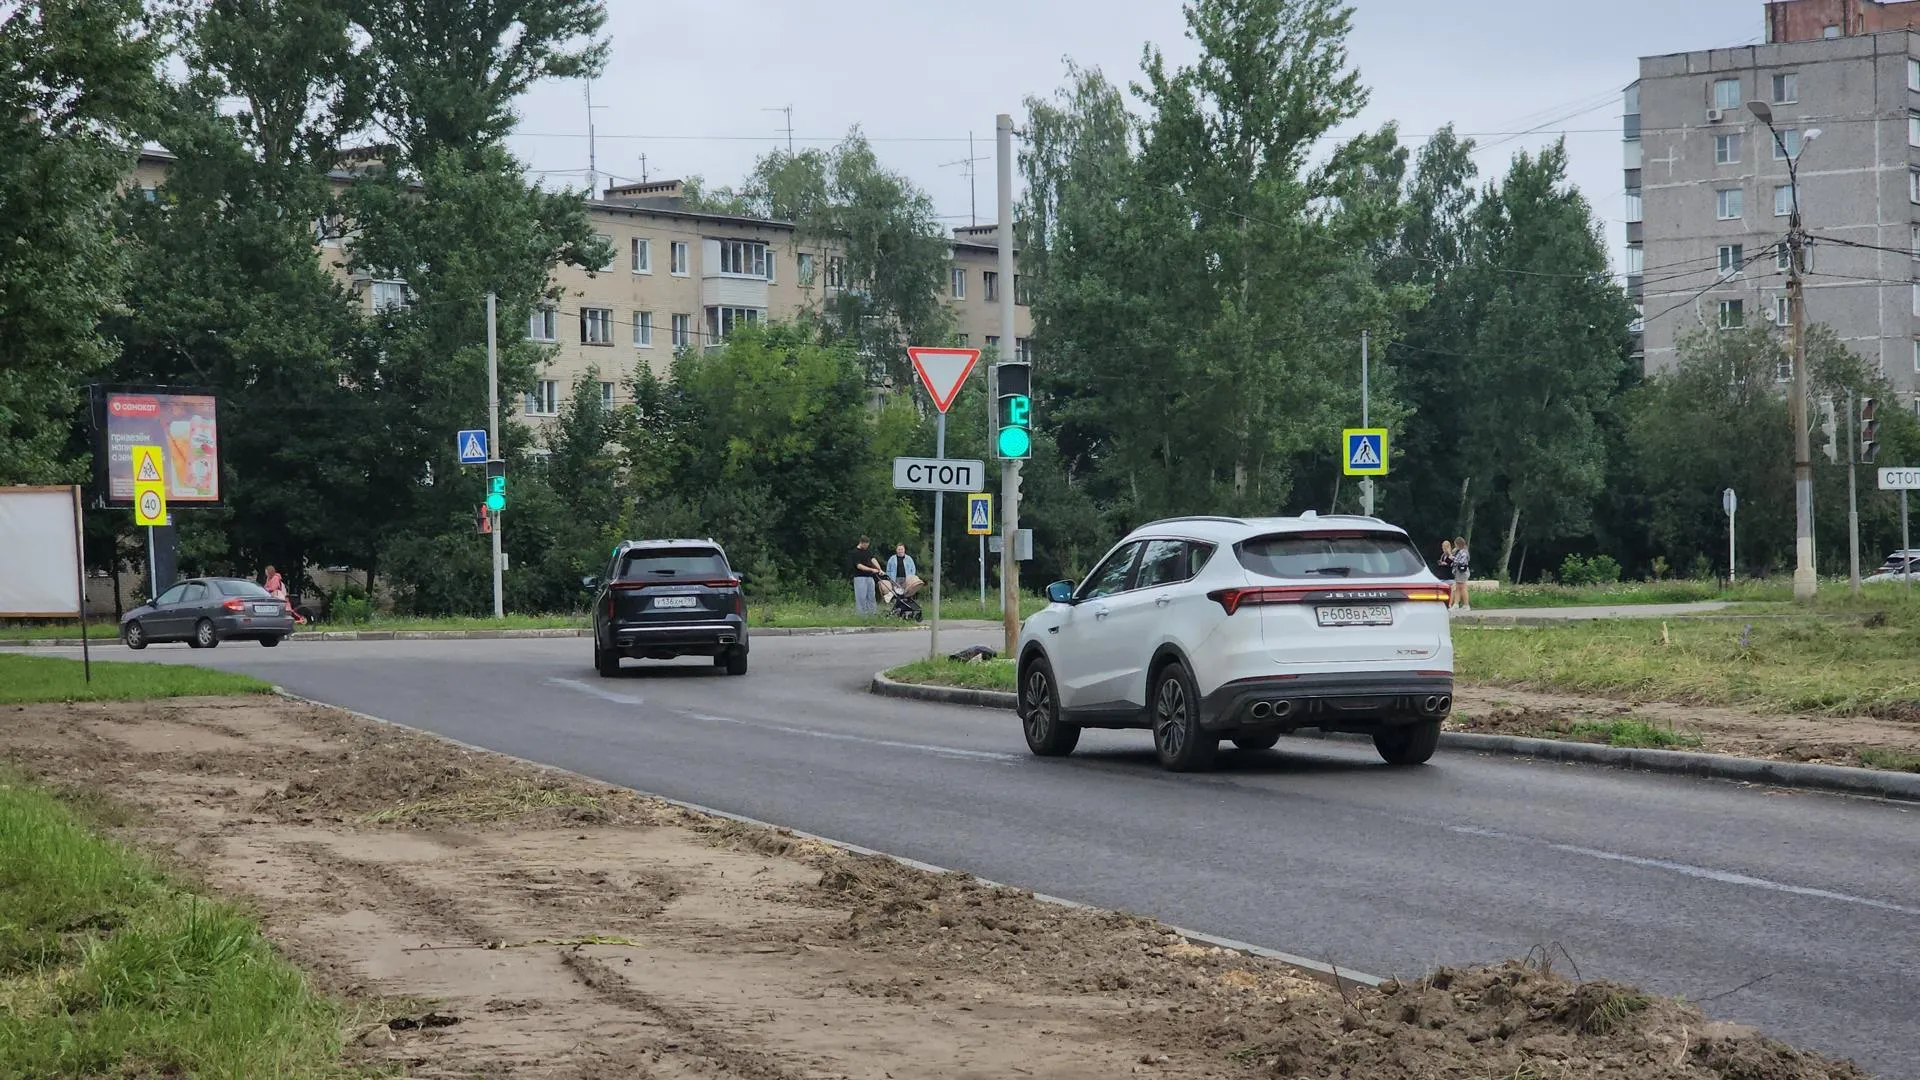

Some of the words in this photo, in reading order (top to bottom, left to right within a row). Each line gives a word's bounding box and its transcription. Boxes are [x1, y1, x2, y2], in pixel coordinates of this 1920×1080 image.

[1010, 396, 1029, 424] 12
[907, 464, 971, 486] СТОП
[144, 499, 157, 511] 40
[1325, 591, 1388, 599] JETOUR
